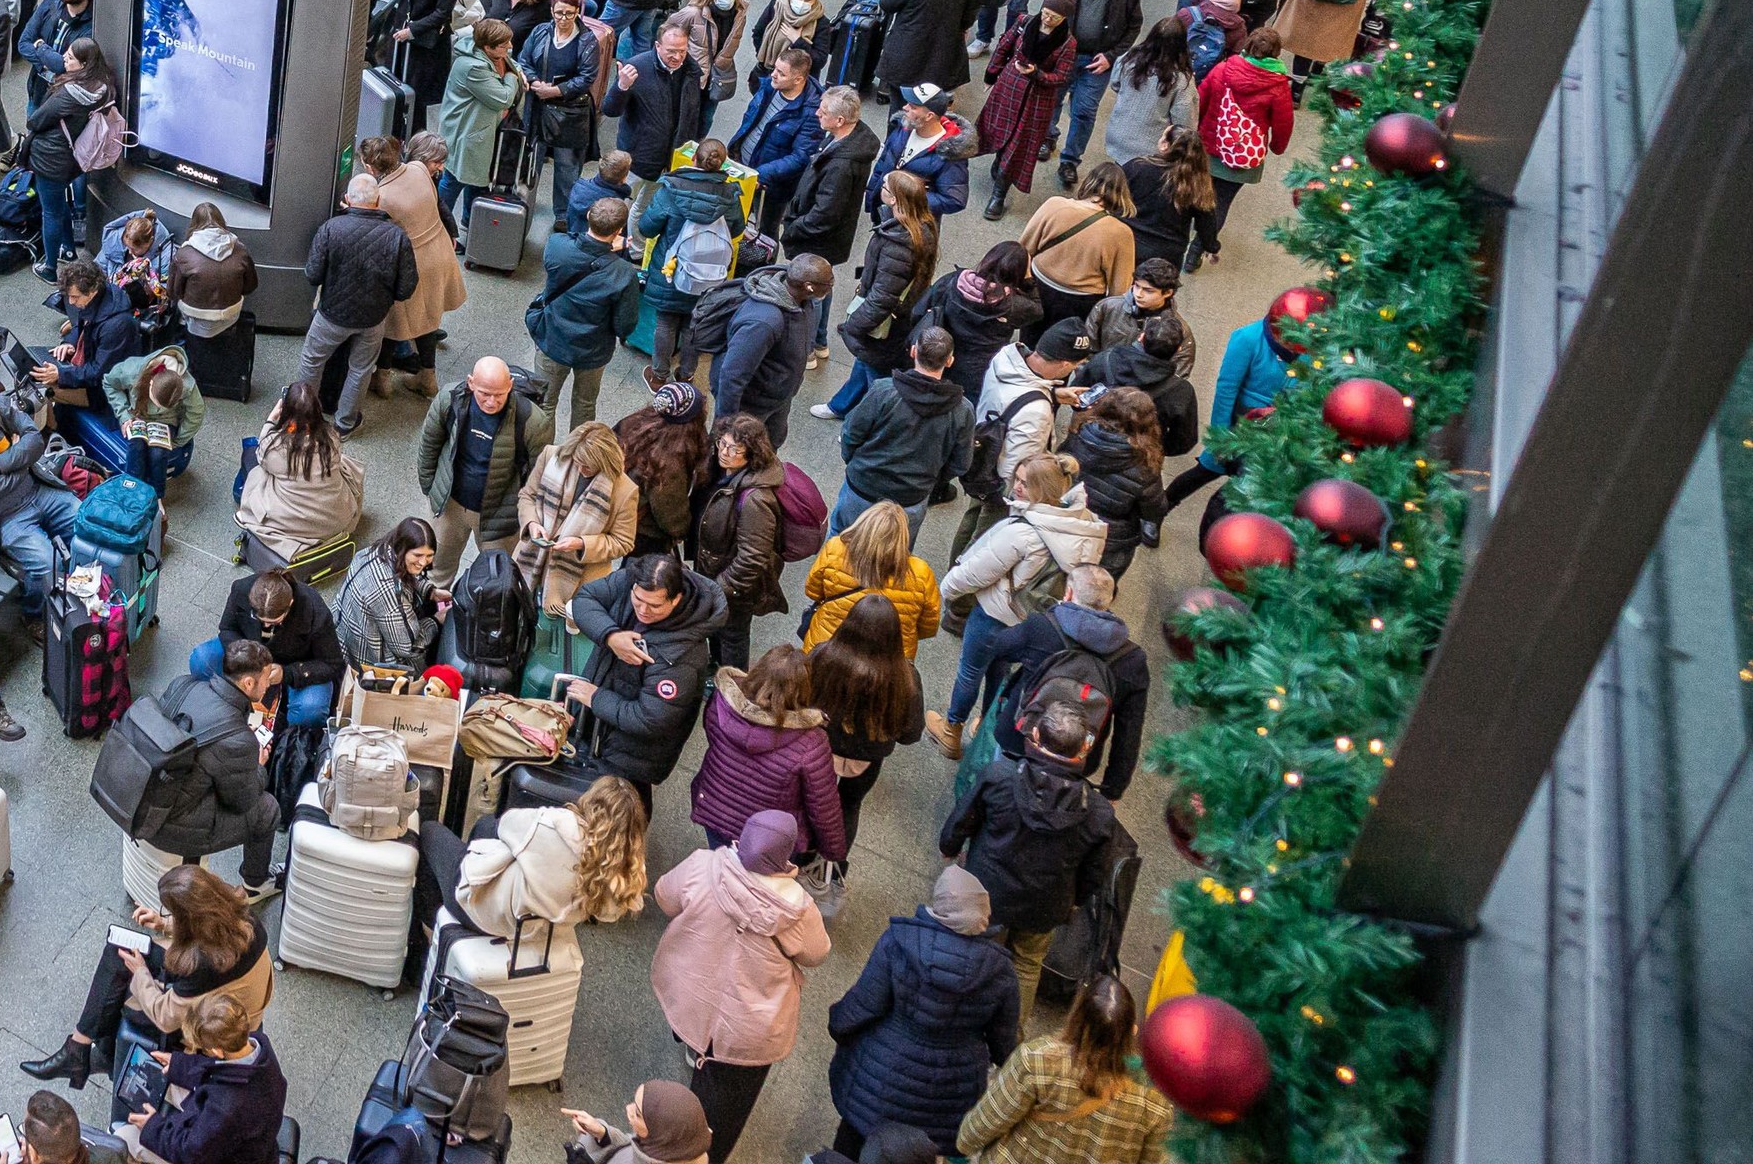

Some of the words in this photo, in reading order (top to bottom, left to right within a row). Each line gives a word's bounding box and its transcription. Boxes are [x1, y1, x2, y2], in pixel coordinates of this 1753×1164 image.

[158, 32, 195, 53] Speak
[197, 43, 256, 71] Mountain
[176, 163, 219, 185] JCDecaux
[389, 716, 428, 737] Harrods
